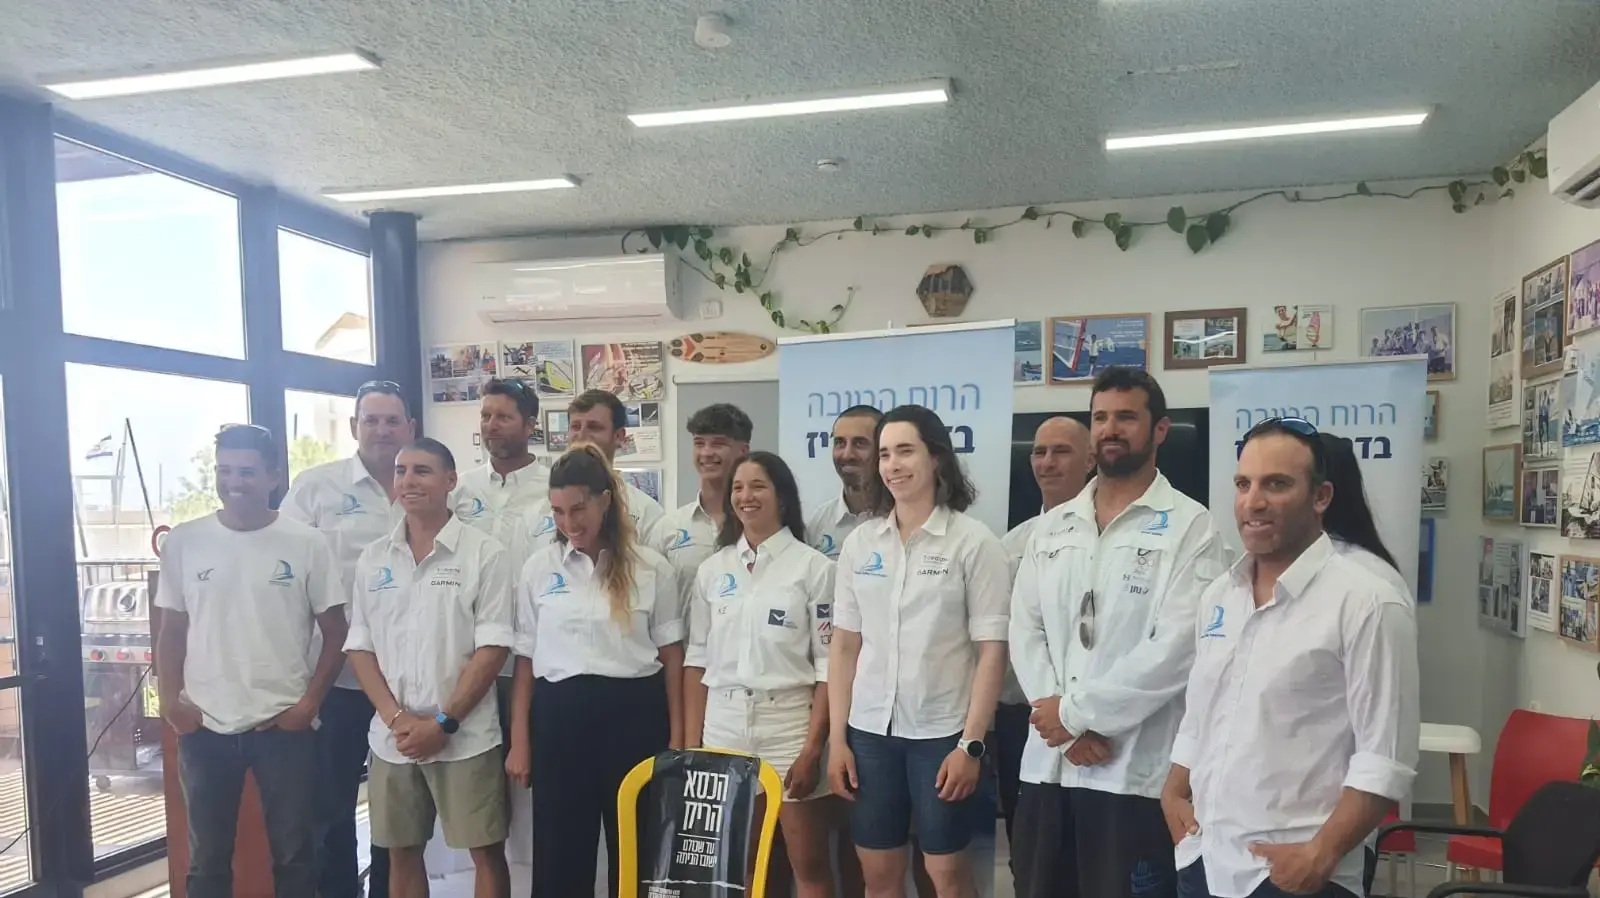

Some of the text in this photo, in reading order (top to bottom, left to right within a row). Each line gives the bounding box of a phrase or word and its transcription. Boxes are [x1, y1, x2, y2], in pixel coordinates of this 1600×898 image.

[909, 383, 981, 410] הרוח
[1331, 403, 1396, 426] הרוח
[683, 770, 729, 802] הכסא
[683, 801, 723, 833] הריק
